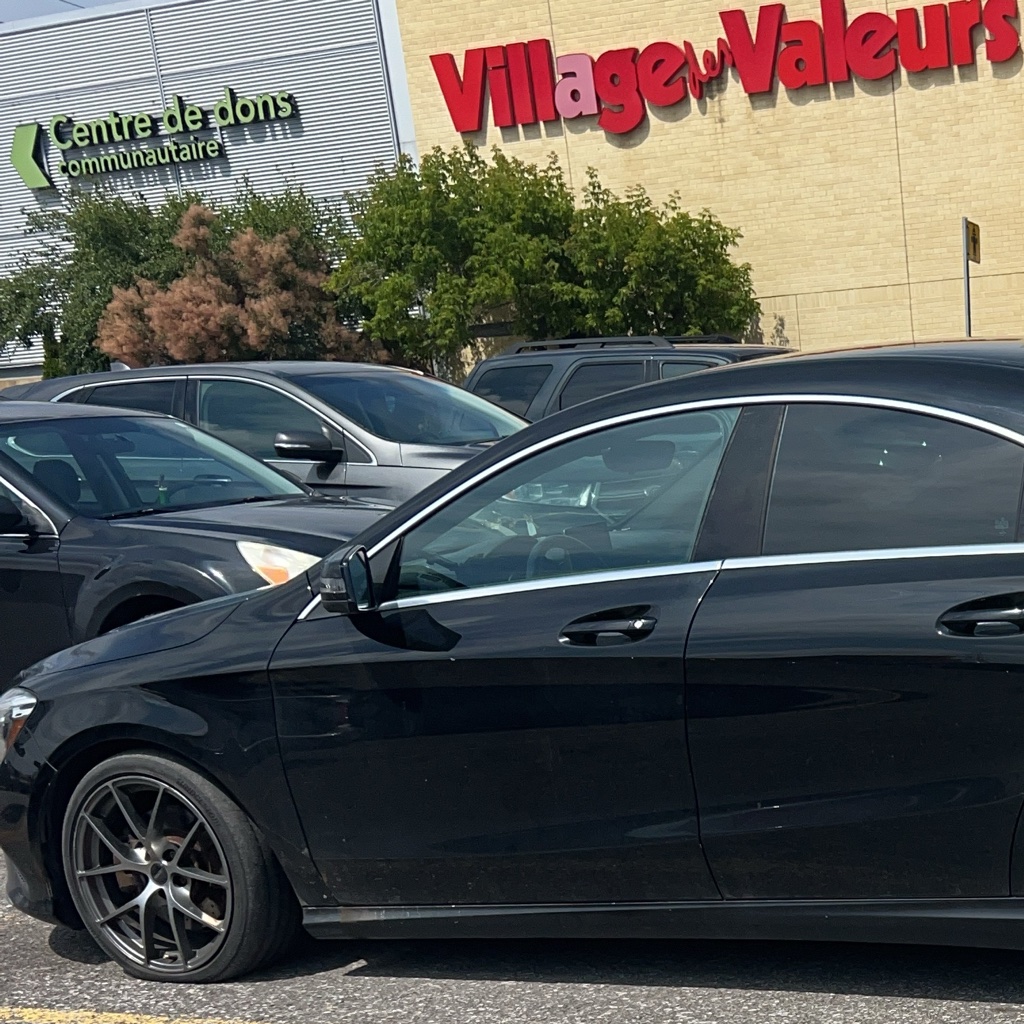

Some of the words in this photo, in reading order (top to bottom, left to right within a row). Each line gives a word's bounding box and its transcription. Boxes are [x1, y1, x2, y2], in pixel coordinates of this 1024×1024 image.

[429, 39, 687, 134] Village
[719, 0, 1020, 94] Valeurs
[50, 113, 152, 150] Centre
[162, 94, 203, 134] de
[213, 86, 294, 126] dons
[58, 136, 219, 177] communautaire
